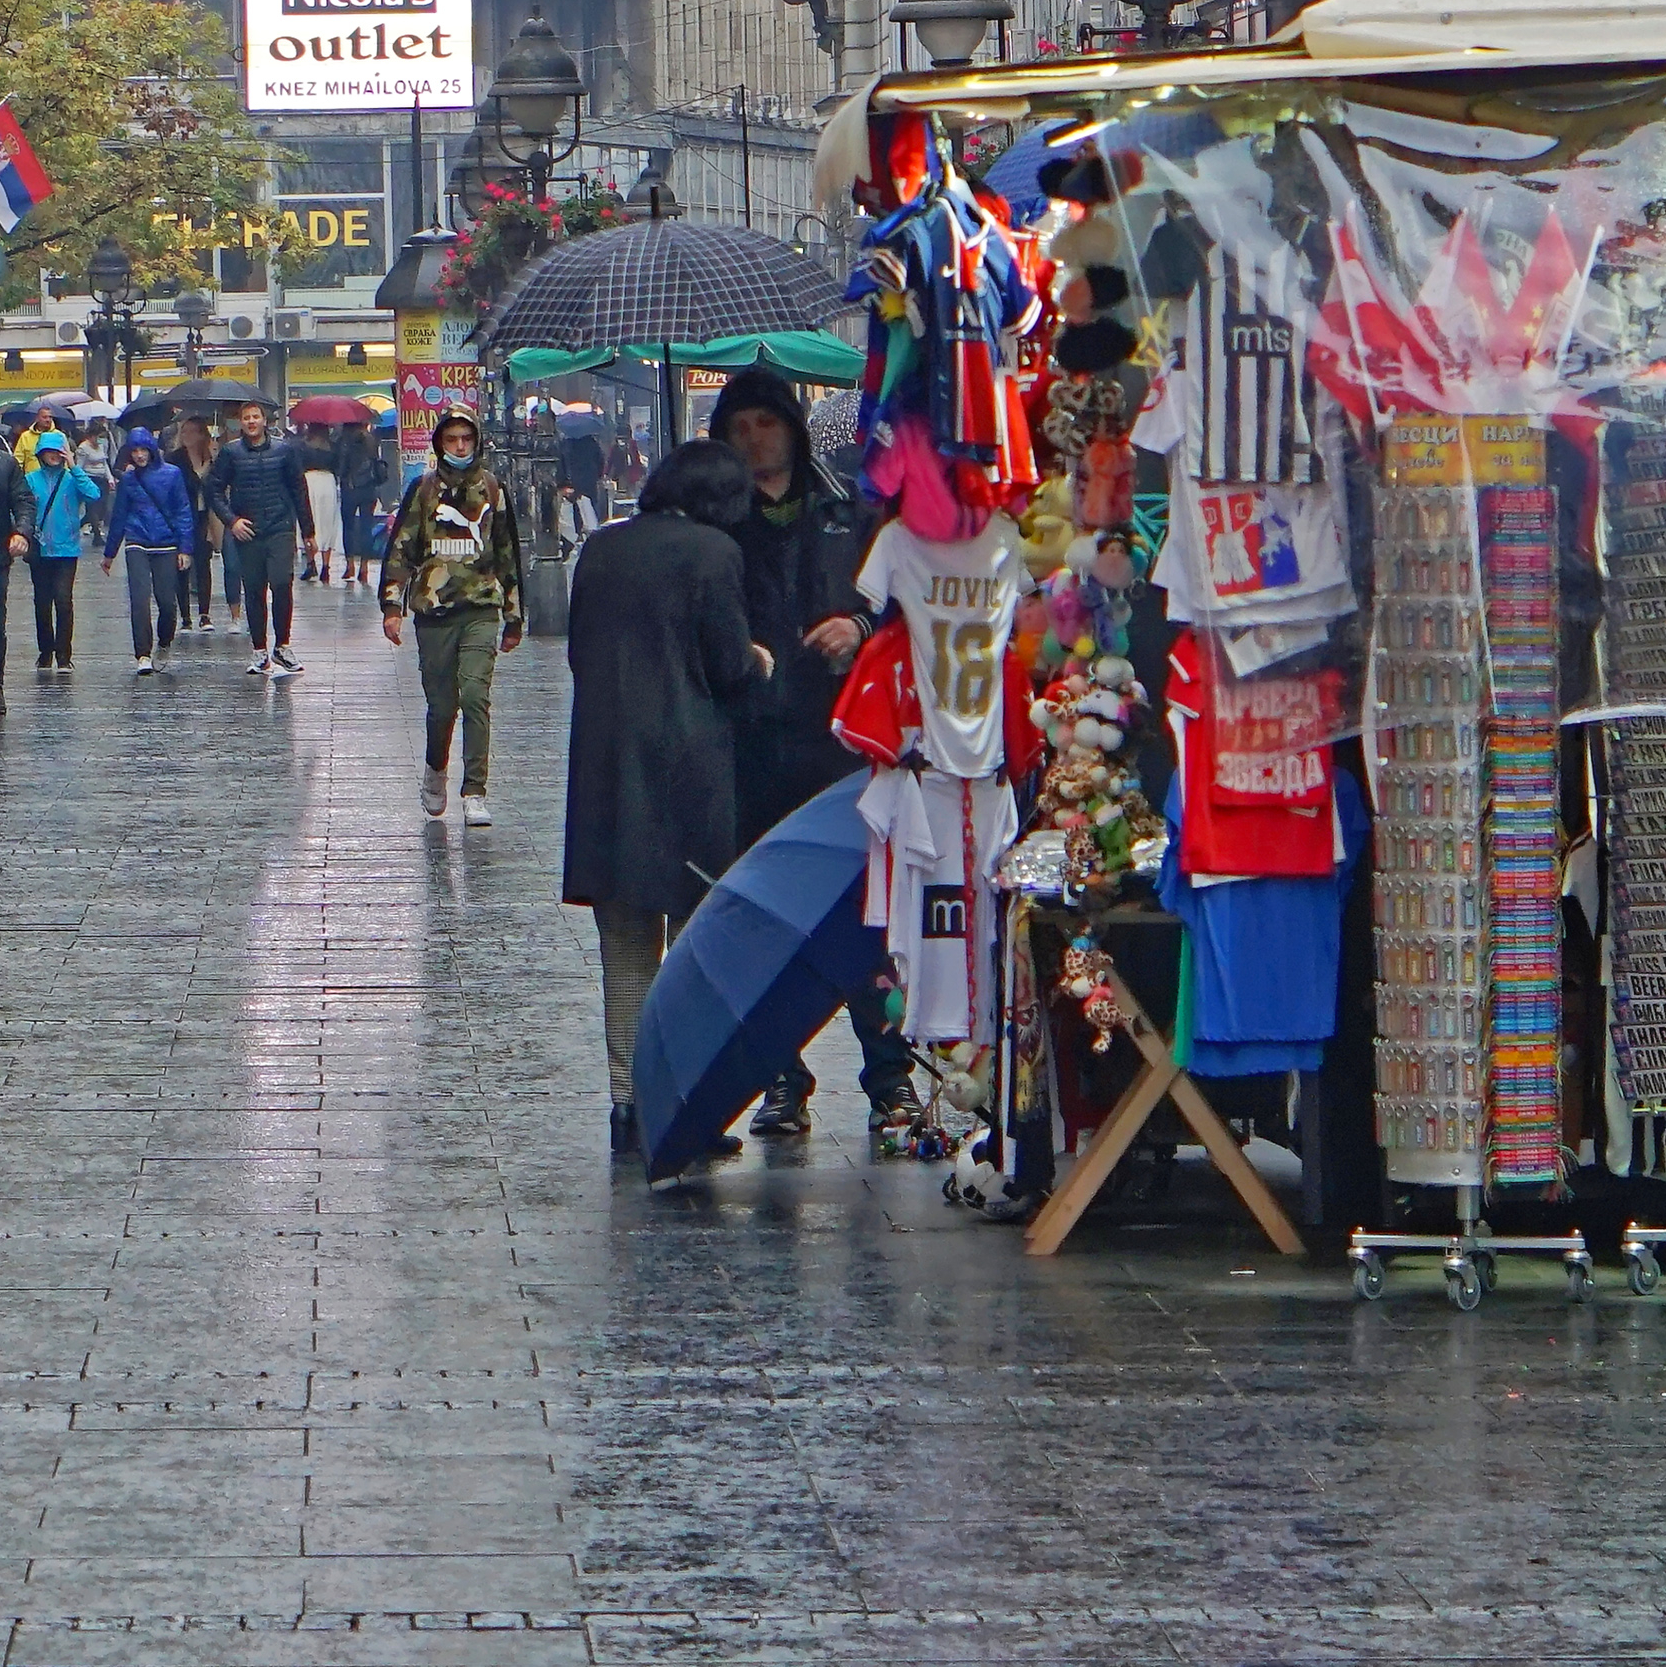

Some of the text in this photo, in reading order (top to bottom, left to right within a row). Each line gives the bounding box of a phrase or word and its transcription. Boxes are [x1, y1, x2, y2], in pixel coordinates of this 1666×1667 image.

[269, 23, 453, 61] outlet
[265, 82, 317, 96] KNEZ
[440, 80, 461, 94] 25
[1231, 318, 1291, 353] mts
[931, 617, 995, 717] 18
[1215, 750, 1326, 799] ЗВЕЗДА
